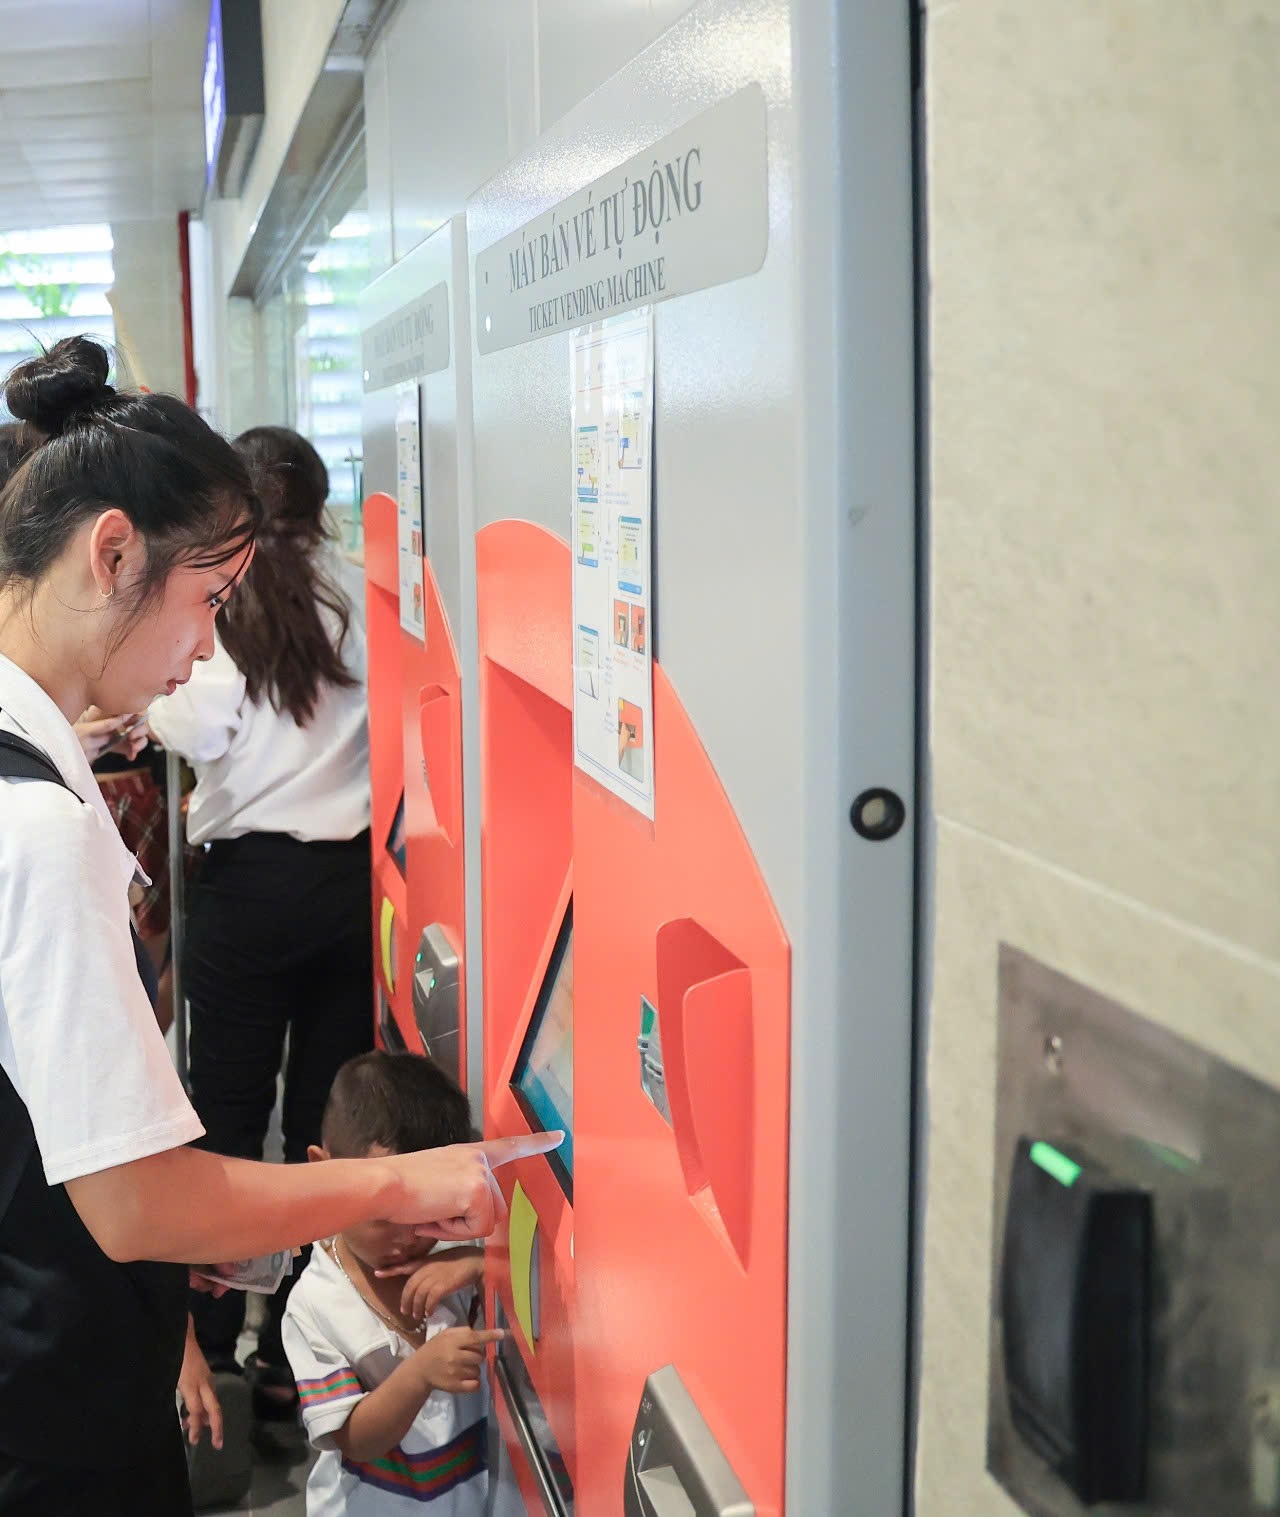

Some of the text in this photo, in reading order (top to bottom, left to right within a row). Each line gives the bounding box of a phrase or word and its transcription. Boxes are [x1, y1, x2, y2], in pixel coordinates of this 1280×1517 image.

[509, 148, 704, 293] MÁY BÁN VÉ TỰ ĐỘNG
[529, 256, 666, 333] TICKET VENDING MACHINE
